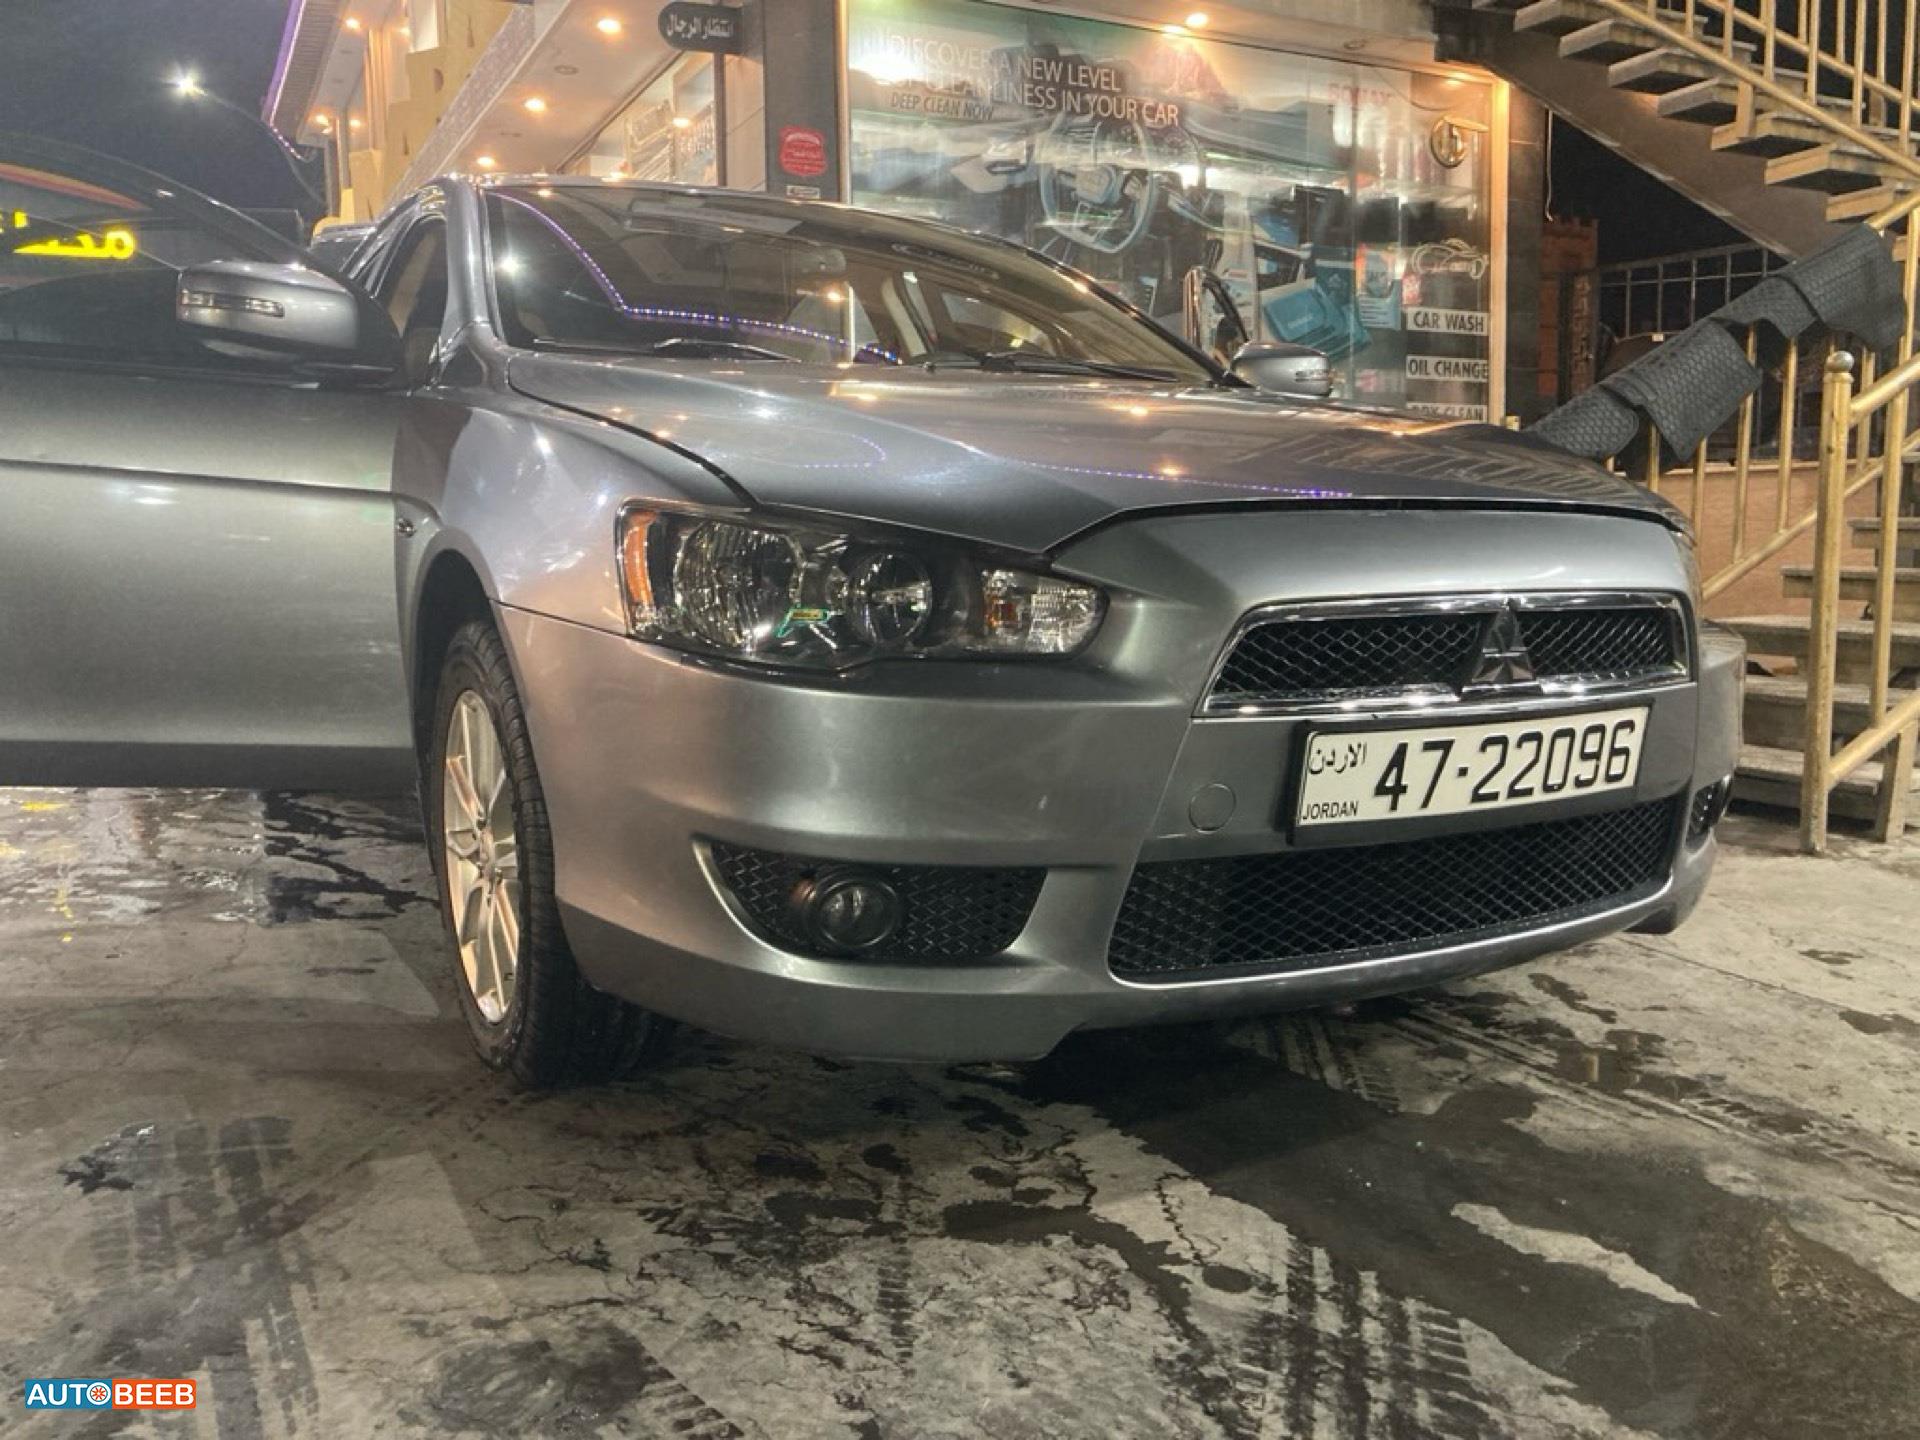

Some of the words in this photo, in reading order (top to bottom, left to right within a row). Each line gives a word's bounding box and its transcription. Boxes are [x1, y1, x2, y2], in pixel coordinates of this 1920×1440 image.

[890, 34, 1000, 71] DISCOVER
[999, 50, 1012, 76] A
[1017, 55, 1064, 84] NEW
[1067, 64, 1122, 93] LEVEL
[890, 91, 920, 110] DEEP
[922, 97, 960, 117] CLEAN
[962, 101, 994, 120] NOW
[1061, 89, 1081, 114] IN
[1087, 94, 1138, 122] YOUR
[1141, 101, 1179, 127] CAR
[1413, 310, 1440, 329] CAR
[1445, 312, 1484, 333] WASH
[1408, 359, 1430, 377] OIL
[1433, 361, 1488, 381] CHANGE
[1303, 801, 1359, 820] JORDAN
